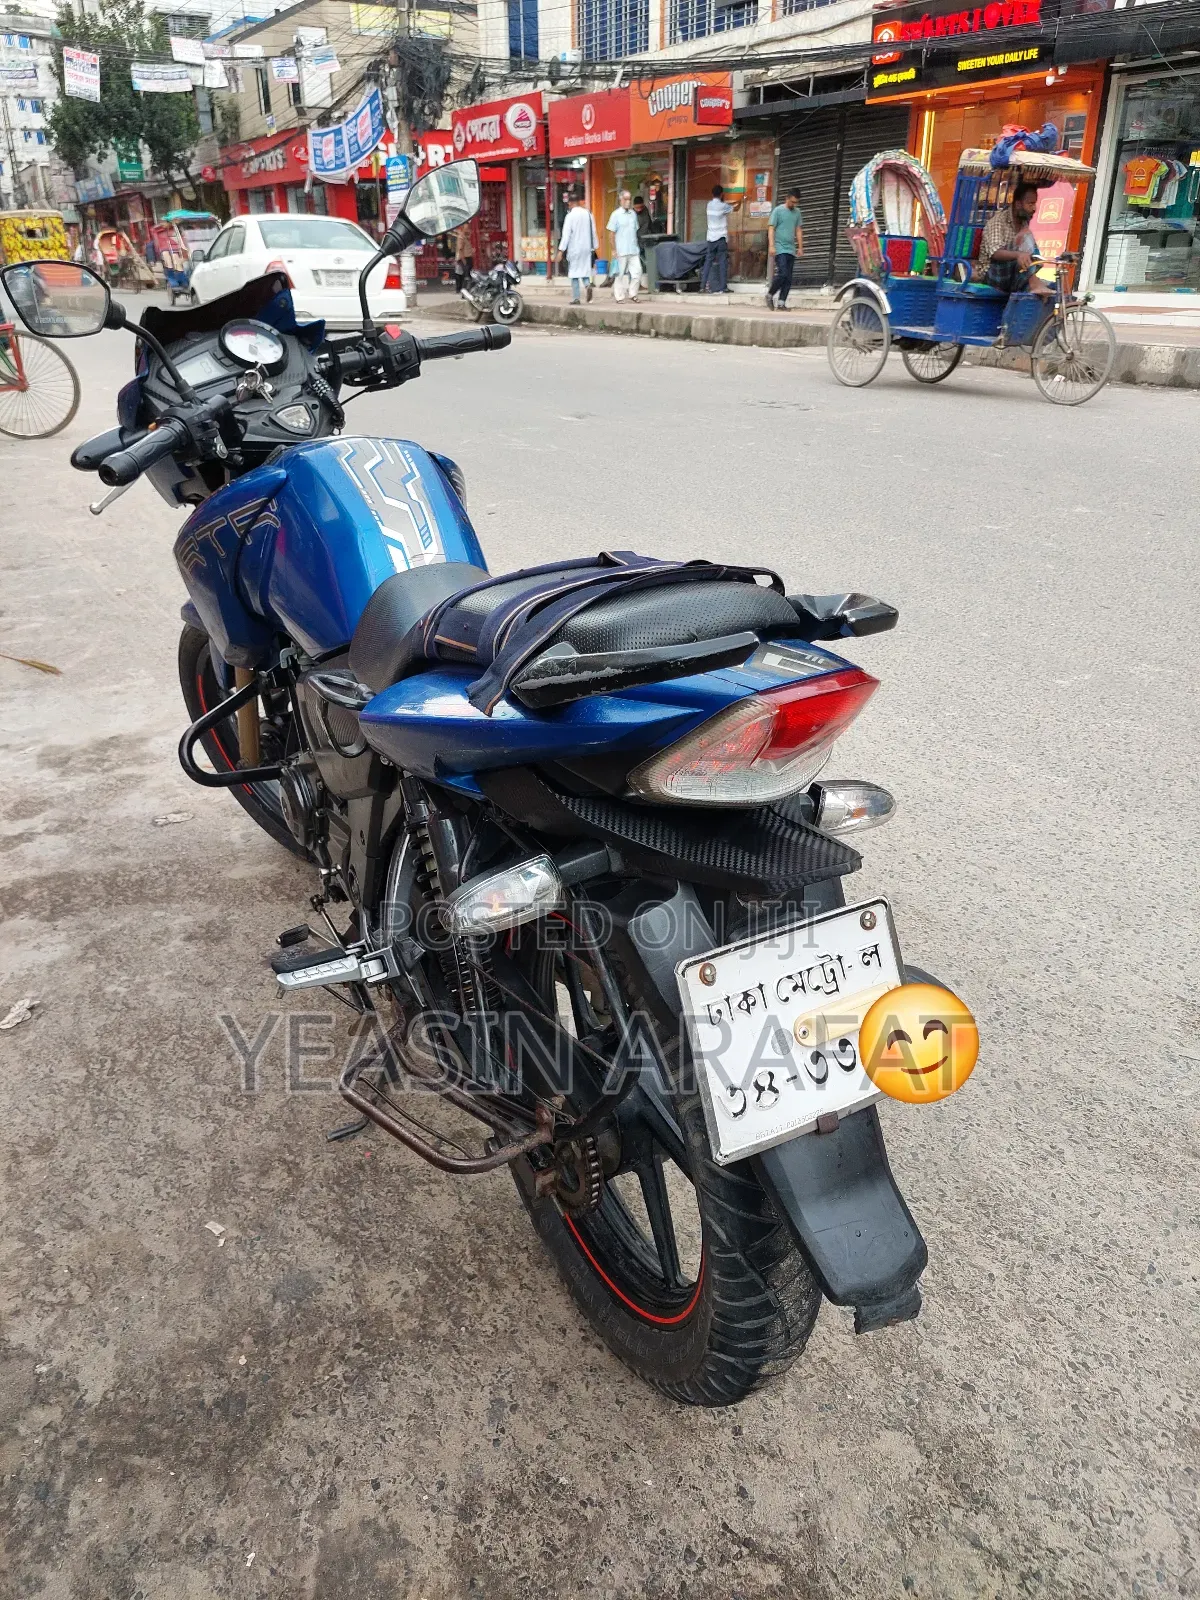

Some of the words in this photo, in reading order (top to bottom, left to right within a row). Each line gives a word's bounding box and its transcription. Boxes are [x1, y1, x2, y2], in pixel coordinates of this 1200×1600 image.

[957, 57, 986, 71] SWEETEN
[987, 54, 1004, 66] YOUR
[1005, 51, 1023, 63] DAILY
[1024, 48, 1039, 60] LIFE
[563, 136, 584, 148] Arabian
[601, 130, 617, 142] Mart
[703, 982, 768, 1026] ঢাকা
[859, 942, 882, 968] ল
[715, 1037, 858, 1120] ৩৪-৩৩
